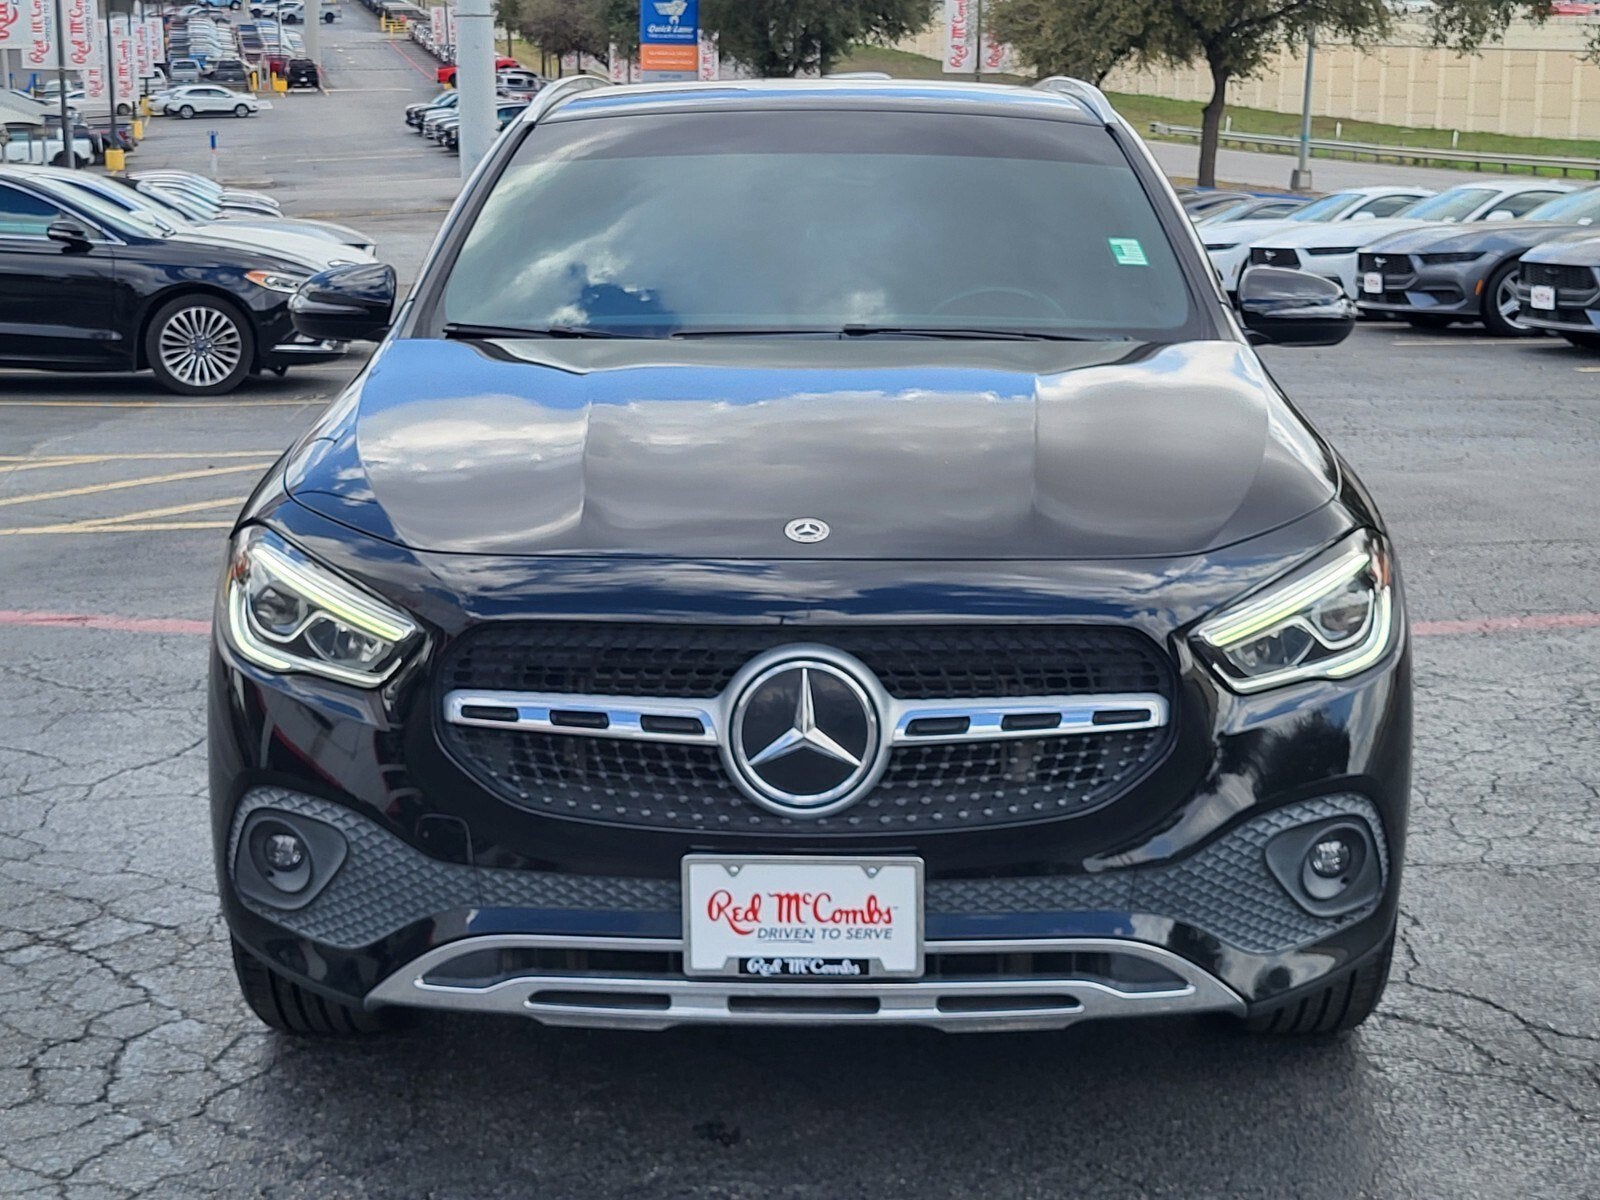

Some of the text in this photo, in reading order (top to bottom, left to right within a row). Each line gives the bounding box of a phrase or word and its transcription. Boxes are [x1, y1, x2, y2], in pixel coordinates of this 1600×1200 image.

[646, 24, 672, 33] Quick
[70, 40, 92, 64] Red
[950, 44, 969, 67] Red
[707, 890, 894, 936] Red McCombs
[757, 927, 894, 941] DRIVEN TO SERVE
[747, 957, 861, 977] Red McCombs
